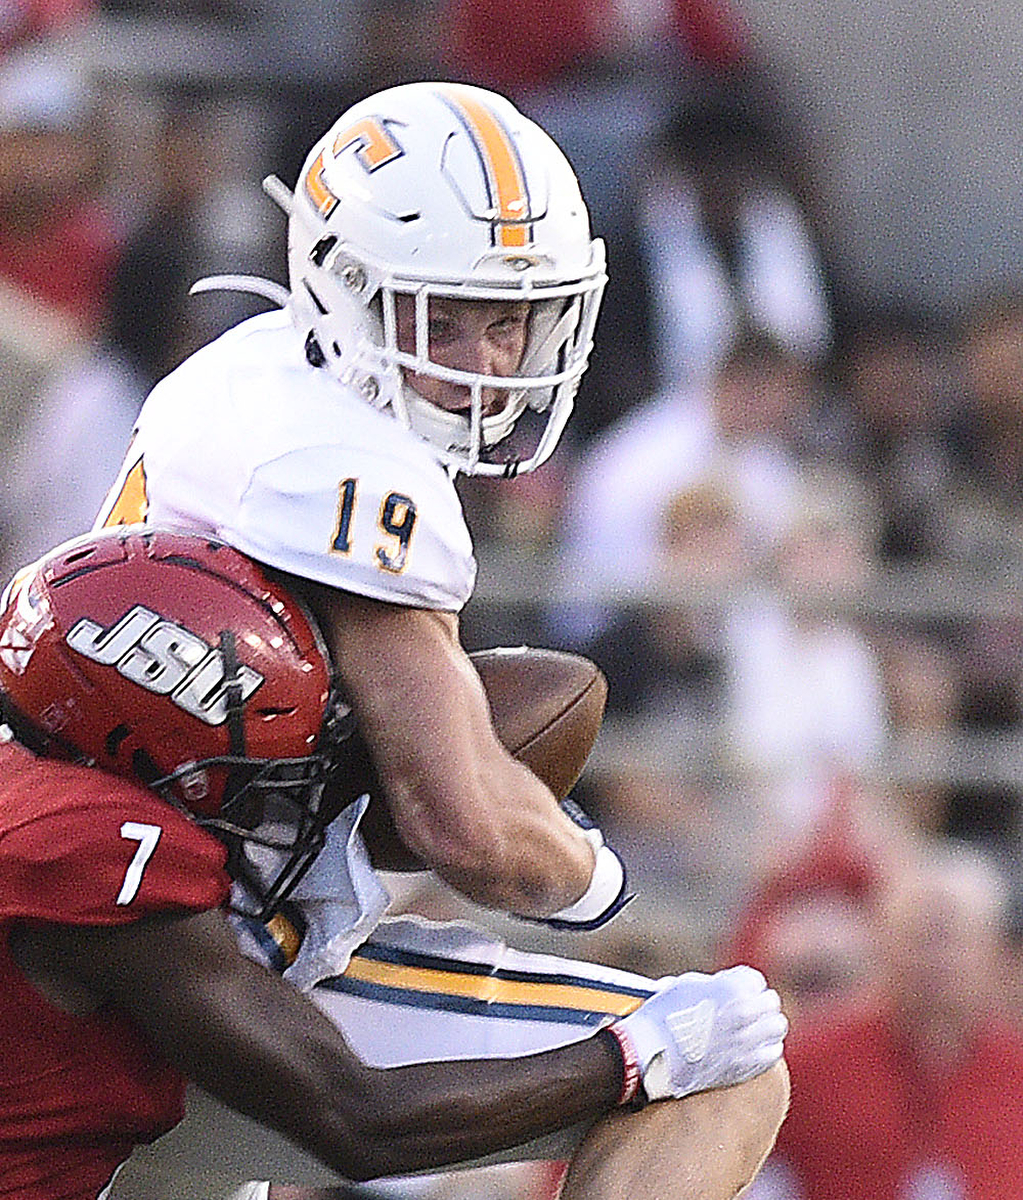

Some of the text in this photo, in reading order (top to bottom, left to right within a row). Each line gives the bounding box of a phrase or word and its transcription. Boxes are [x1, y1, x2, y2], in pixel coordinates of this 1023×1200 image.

[327, 477, 418, 575] 19
[65, 604, 265, 726] JSU
[116, 821, 162, 906] 7
